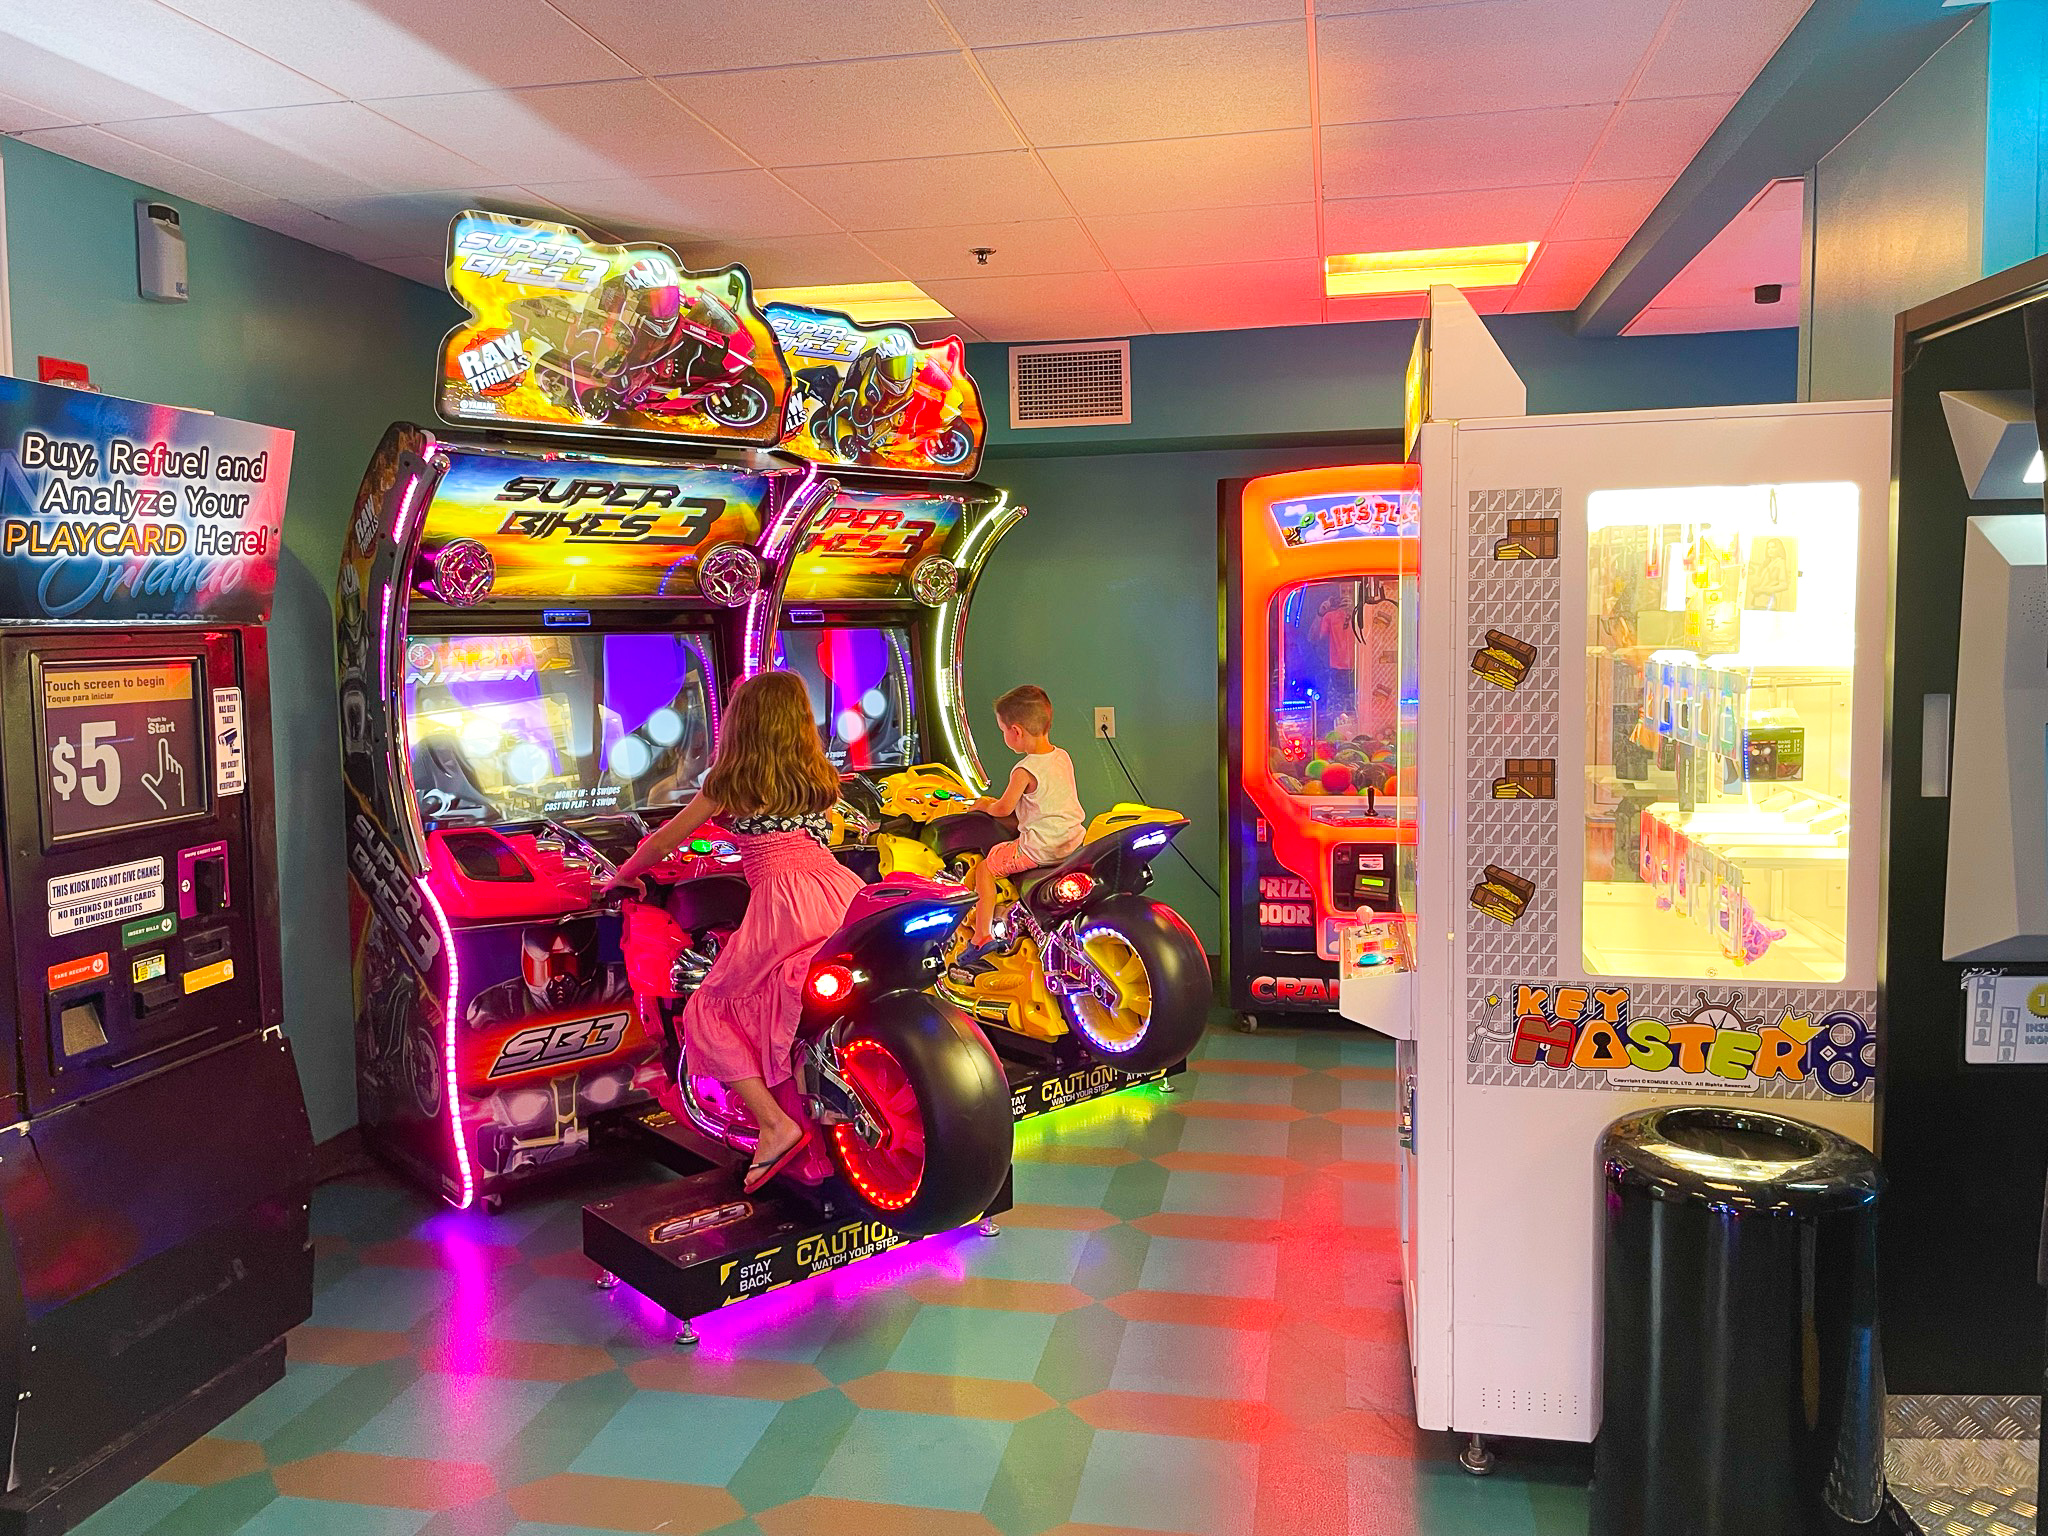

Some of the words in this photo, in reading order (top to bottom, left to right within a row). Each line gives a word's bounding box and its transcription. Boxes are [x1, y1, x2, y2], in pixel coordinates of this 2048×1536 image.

[459, 231, 582, 265] SUPER
[461, 253, 569, 284] BIKES
[771, 318, 849, 341] SUPER
[458, 330, 524, 380] RAW
[467, 355, 532, 393] THRILLS
[24, 433, 98, 478] Buy,
[111, 441, 208, 478] Refuel
[217, 453, 268, 481] and
[42, 480, 176, 519] Analyze
[186, 488, 249, 517] Your
[494, 475, 681, 510] SUPER
[495, 510, 662, 540] BIKES
[813, 507, 906, 533] UPER
[5, 522, 187, 555] PLAYCARD
[196, 525, 268, 554] Here!
[45, 680, 81, 692] Touch
[84, 679, 120, 690] screen
[123, 677, 134, 688] to
[137, 676, 165, 688] begin
[405, 669, 535, 686] NIKEN
[47, 694, 71, 703] Toque
[72, 694, 90, 702] para
[147, 721, 176, 734] Start
[52, 720, 121, 806] $5
[544, 802, 560, 811] COST
[561, 801, 570, 810] TO
[571, 800, 589, 809] PLAY:
[52, 883, 71, 898] THIS
[70, 879, 91, 895] KIOSK
[91, 877, 108, 890] DOES
[109, 873, 121, 886] NOT
[122, 870, 136, 883] GIVE
[137, 865, 161, 880] CHANGE
[353, 814, 422, 916] SUPER
[352, 842, 413, 932] BIKES
[58, 910, 68, 919] NO
[70, 902, 102, 917] REFUNDS
[103, 900, 113, 909] ON
[114, 895, 133, 906] GAME
[134, 889, 156, 900] CARDS
[74, 916, 84, 926] OR
[86, 909, 113, 923] UNUSED
[114, 903, 143, 916] CREDITS
[1516, 984, 1630, 1021] KEY
[490, 1013, 630, 1077] SB3
[1512, 1014, 1806, 1081] MASTER
[1011, 1094, 1027, 1107] TAY
[1041, 1068, 1119, 1102] CAUTION!
[1051, 1093, 1076, 1107] WATCH
[1076, 1087, 1094, 1099] YOUR
[1094, 1083, 1110, 1094] STEP
[740, 1259, 772, 1279] STAY
[811, 1252, 847, 1271] WATCH
[849, 1243, 875, 1259] YOUR
[875, 1235, 899, 1250] STEP
[740, 1272, 773, 1292] BACK
